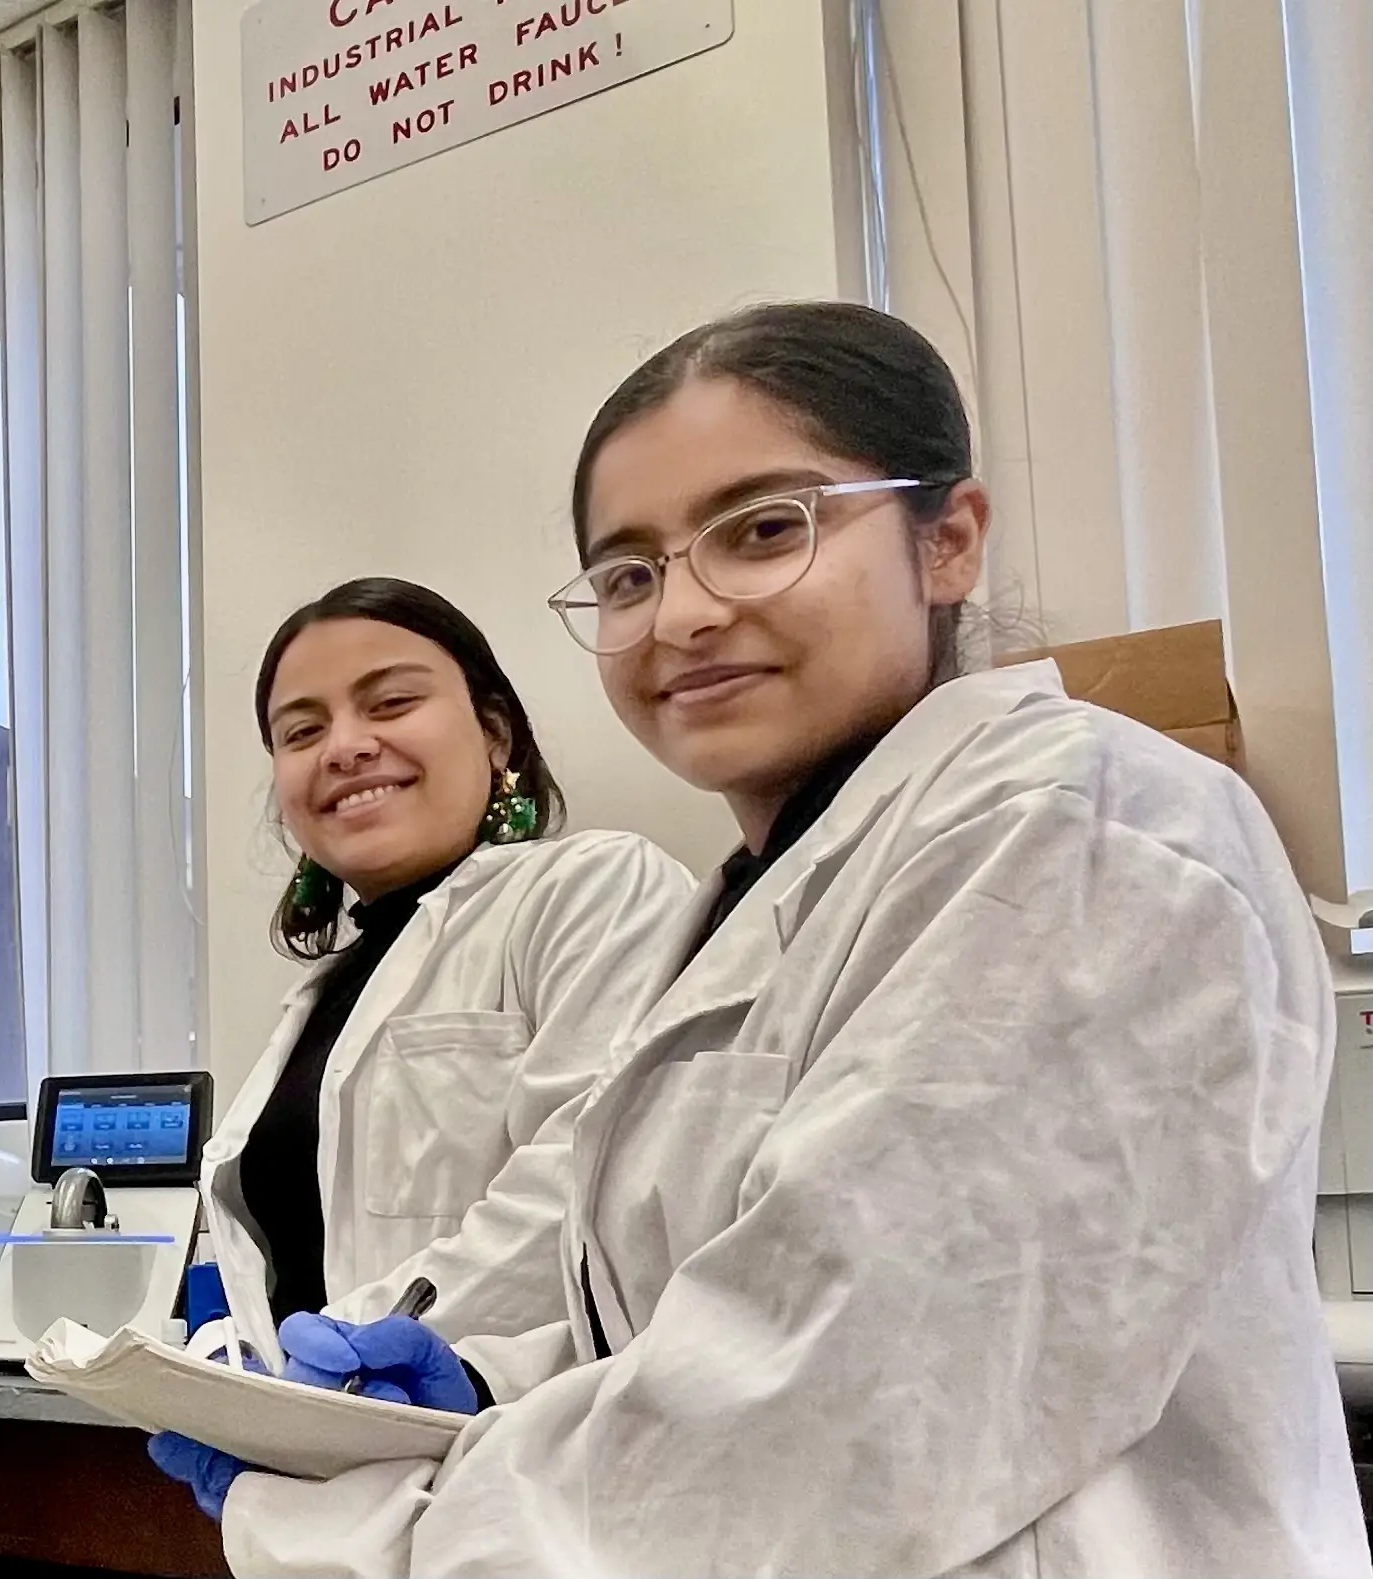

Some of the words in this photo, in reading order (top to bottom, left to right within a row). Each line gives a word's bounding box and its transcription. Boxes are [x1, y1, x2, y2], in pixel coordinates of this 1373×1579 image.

[267, 4, 464, 103] INDUSTRIAL
[279, 103, 343, 145] ALL
[368, 43, 479, 107] WATER
[516, 0, 630, 47] FAUC
[323, 138, 362, 172] DO
[392, 99, 456, 146] NOT
